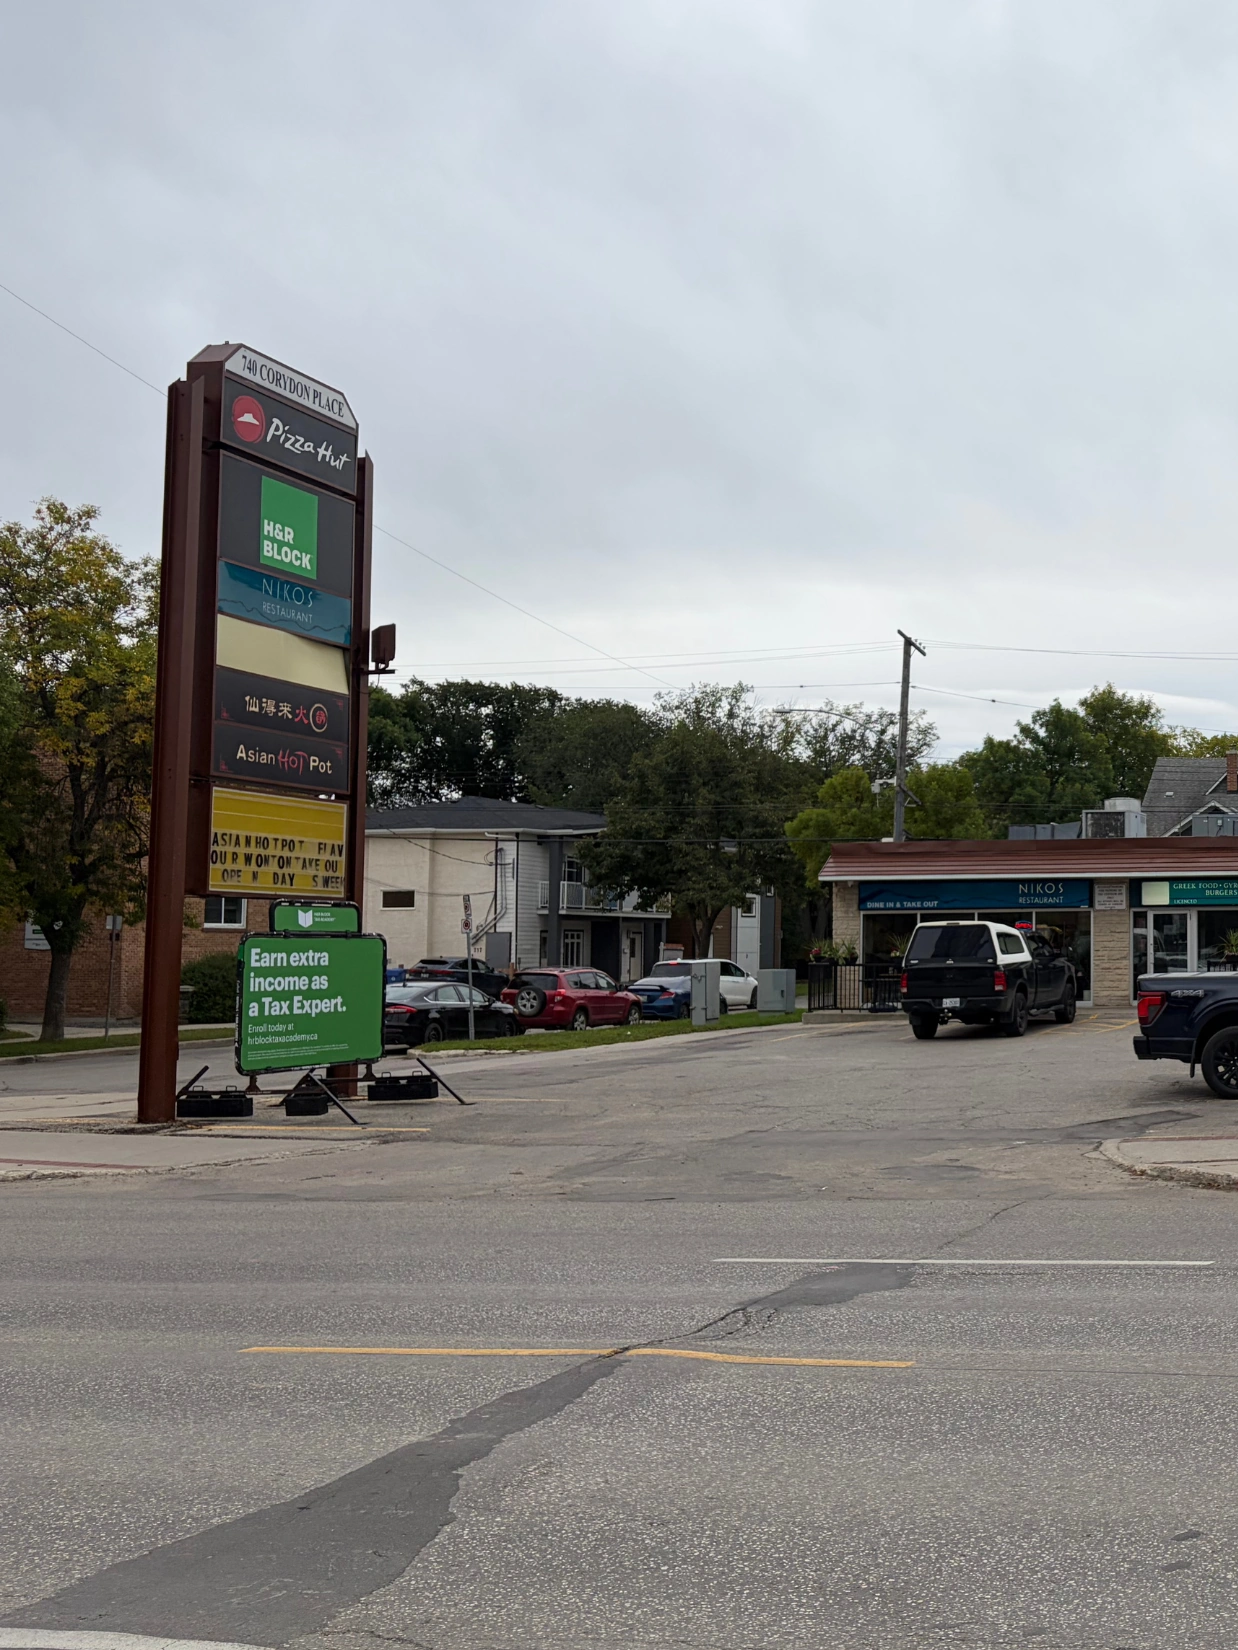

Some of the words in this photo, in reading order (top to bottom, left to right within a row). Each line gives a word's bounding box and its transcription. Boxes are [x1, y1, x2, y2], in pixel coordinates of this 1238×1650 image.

[242, 355, 257, 376] 740
[259, 364, 310, 400] CORYDON
[313, 389, 345, 418] PLACE
[266, 418, 314, 454] Pizza
[317, 441, 352, 471] Hut
[263, 519, 294, 544] H&R
[263, 540, 312, 570] BLOCK
[262, 578, 313, 608] NIKOS
[262, 602, 313, 623] RESTAURANT
[236, 744, 276, 765] Asian
[310, 755, 333, 775] Pot
[212, 832, 252, 849] ASIAN
[210, 850, 238, 865] OUR
[1018, 882, 1064, 894] NIKOS
[1018, 896, 1064, 904] RESTAURANT
[251, 948, 287, 967] Earn
[289, 949, 329, 966] extra
[250, 972, 309, 992] income
[311, 976, 329, 990] as
[248, 1003, 259, 1017] a
[261, 997, 290, 1016] Tax
[293, 995, 347, 1017] Expert.
[248, 1024, 267, 1033] Enroll
[268, 1023, 286, 1034] today
[287, 1023, 294, 1031] at
[247, 1033, 318, 1045] hrblocktaxacademy.ca
